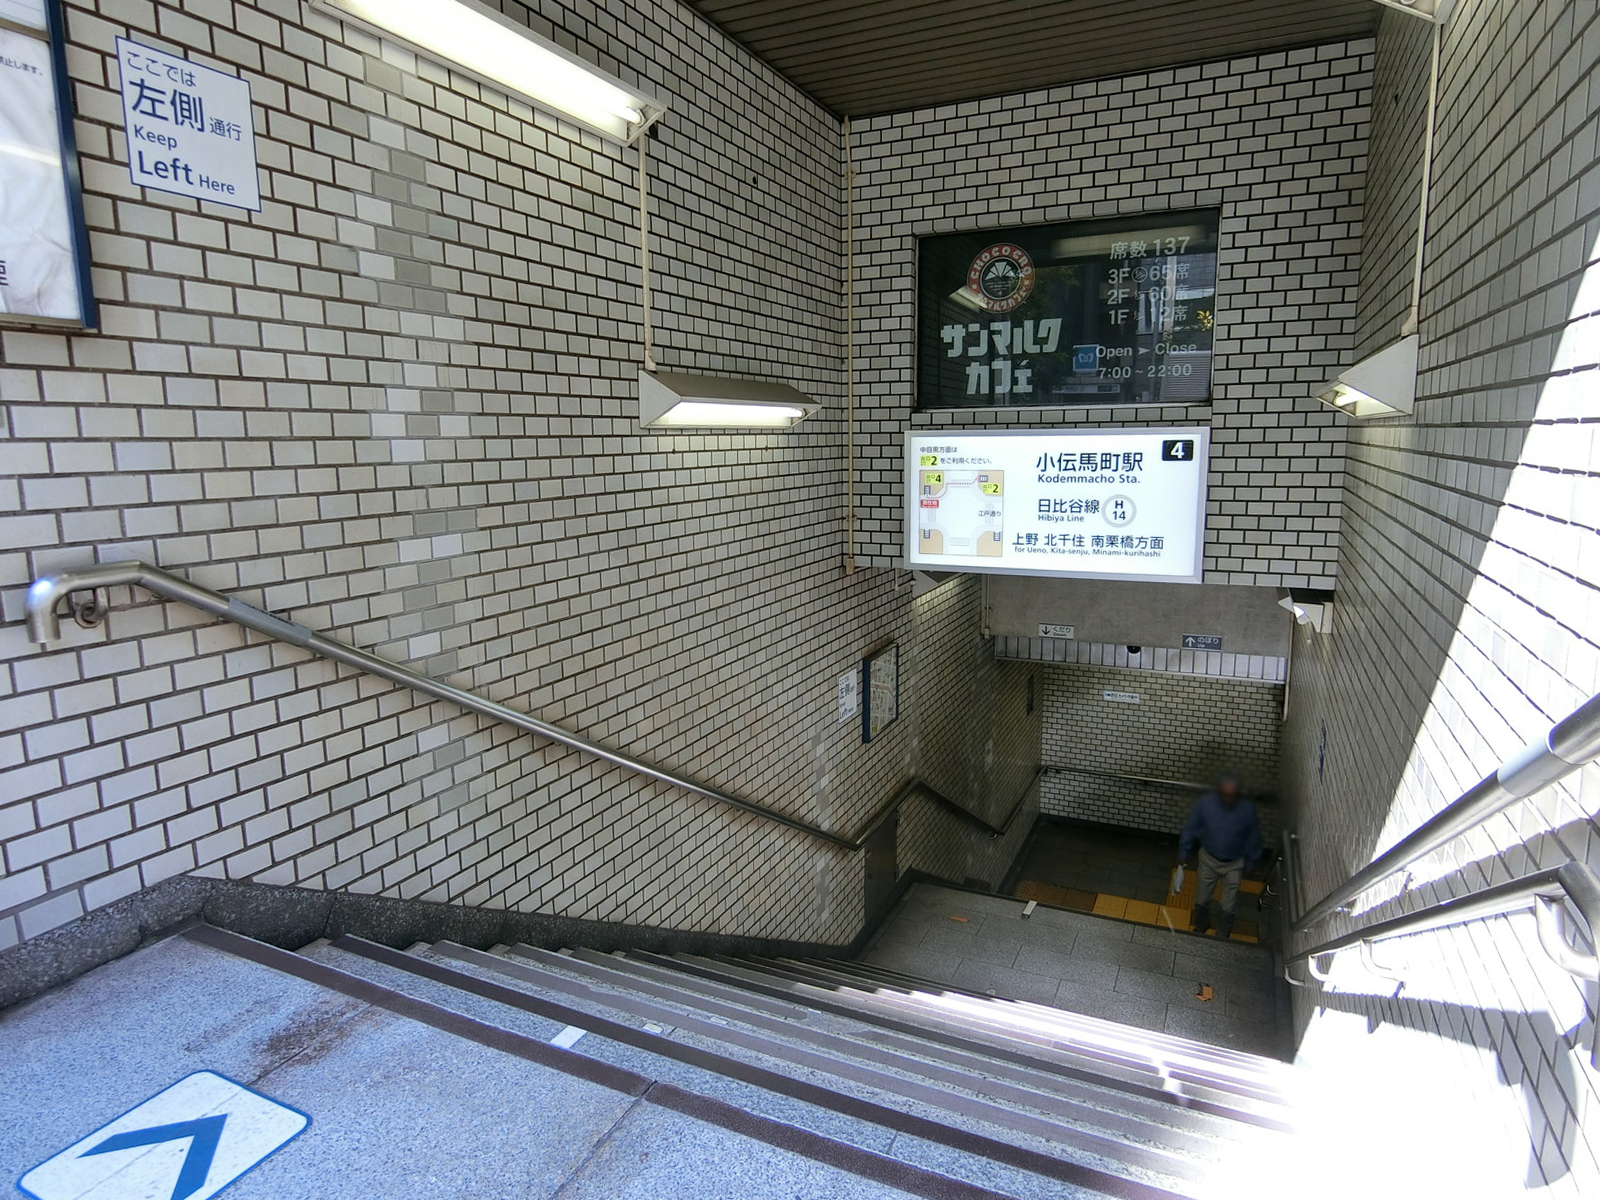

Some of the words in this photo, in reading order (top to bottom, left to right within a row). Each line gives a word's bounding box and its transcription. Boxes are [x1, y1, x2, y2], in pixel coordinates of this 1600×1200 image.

[127, 51, 196, 87] ここでは
[129, 78, 205, 132] 左側
[210, 116, 242, 141] 通行
[134, 124, 178, 151] Keep
[138, 150, 194, 185] Left
[199, 174, 235, 194] Here
[1110, 240, 1147, 260] 席数
[1153, 236, 1190, 256] 137
[1107, 268, 1131, 284] 3F
[1107, 288, 1130, 305] 2F
[1108, 309, 1130, 325] 1F
[940, 317, 1063, 358] サンマルク
[1096, 346, 1133, 359] Open
[1155, 342, 1197, 355] Close
[965, 359, 1033, 395] カフェ
[1099, 366, 1131, 379] 7:00
[1147, 364, 1192, 377] 22:00
[919, 446, 958, 454] 中目黒方面は
[1170, 442, 1185, 459] 4
[1036, 452, 1143, 473] 小伝馬町駅
[1038, 474, 1115, 484] Kodemmacho
[1119, 474, 1141, 484] Sta.
[1038, 498, 1100, 514] 日比谷線
[1115, 500, 1124, 509] H
[1037, 514, 1064, 523] Hibiya
[1067, 514, 1085, 522] Line
[1112, 510, 1126, 521] 14
[1012, 532, 1039, 547] 上野
[1043, 533, 1085, 547] 北千住
[1091, 534, 1164, 550] 南栗橋方面
[1027, 546, 1049, 554] Ueno,
[1050, 548, 1090, 557] Kita-senju,
[1092, 549, 1161, 557] Minami-kurihashi
[1052, 626, 1072, 634] くだり
